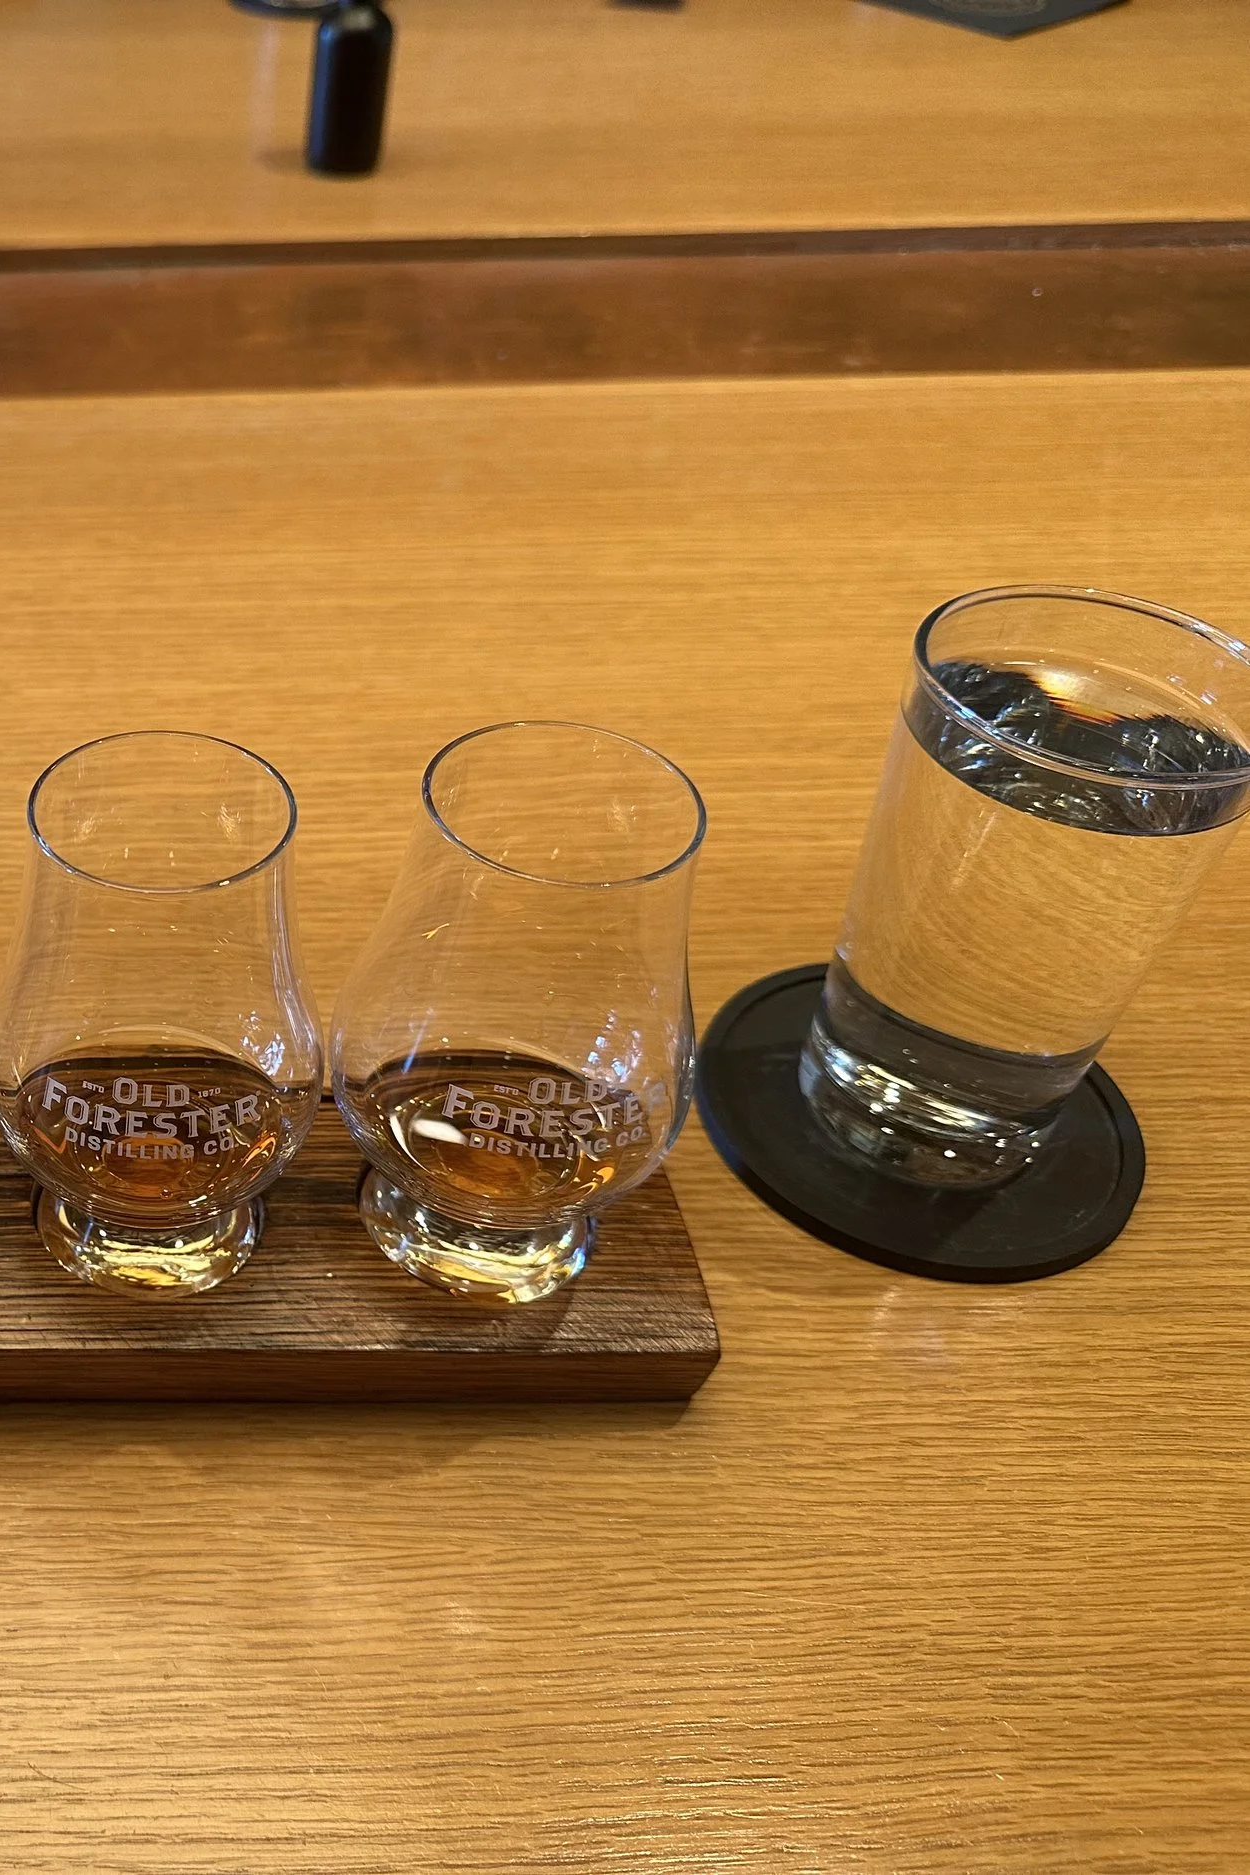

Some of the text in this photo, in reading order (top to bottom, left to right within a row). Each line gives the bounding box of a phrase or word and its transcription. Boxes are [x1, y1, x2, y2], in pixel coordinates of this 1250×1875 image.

[112, 1077, 190, 1108] OLD
[197, 1087, 221, 1098] 1870
[527, 1077, 609, 1105] OLD
[42, 1076, 261, 1139] FORESTER
[442, 1082, 668, 1138] FORESTER
[64, 1126, 195, 1160] DISTILLING
[469, 1133, 608, 1158] DISTILLING
